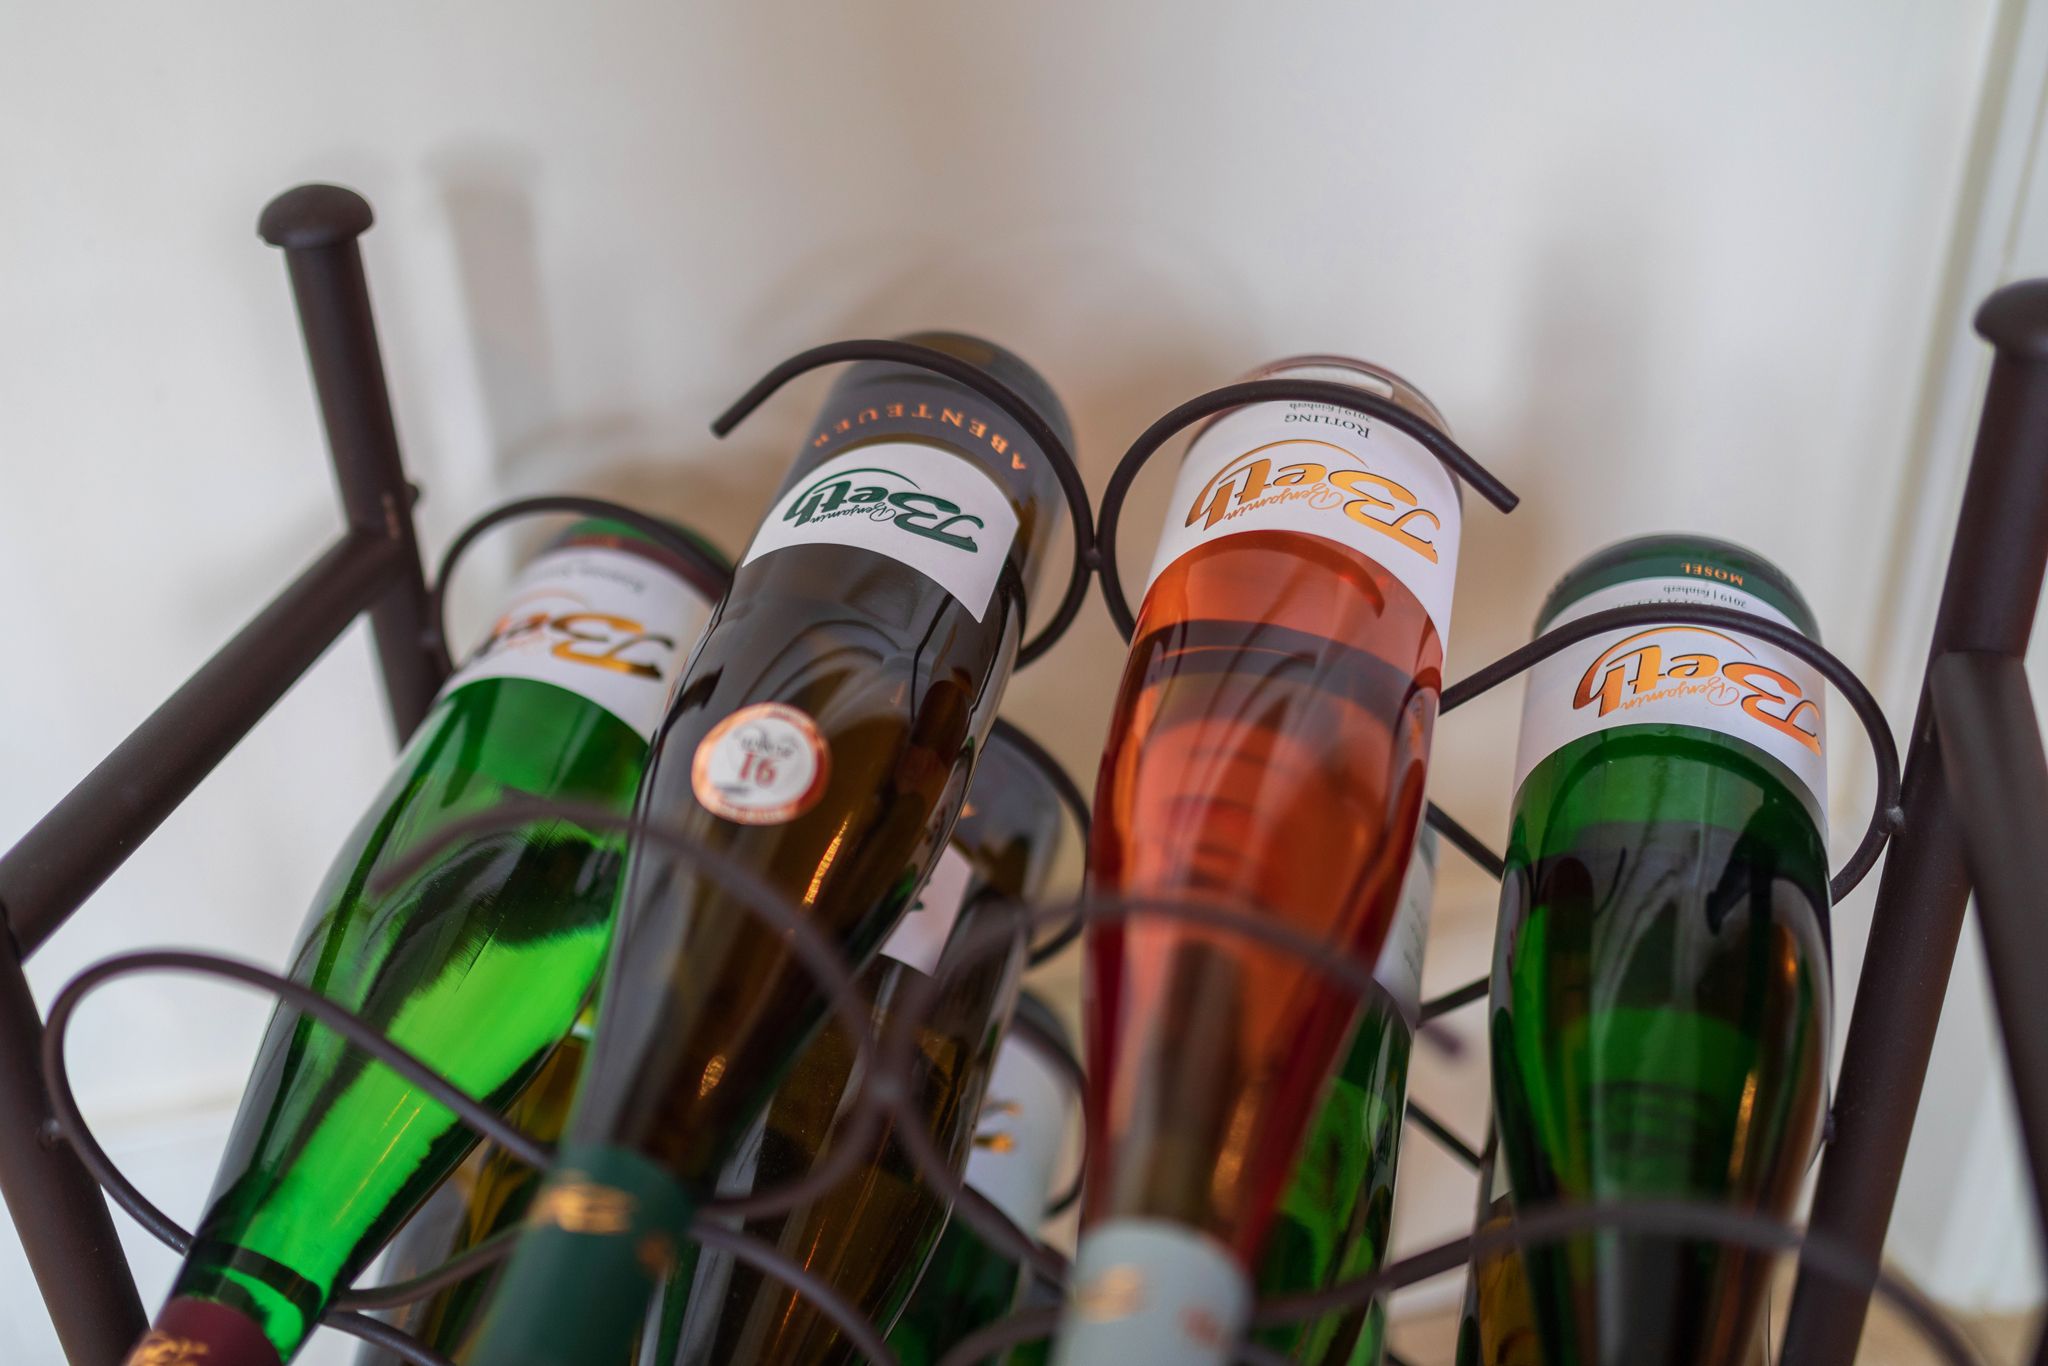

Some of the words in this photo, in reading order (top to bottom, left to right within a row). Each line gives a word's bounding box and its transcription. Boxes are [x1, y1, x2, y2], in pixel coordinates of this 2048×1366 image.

[1284, 413, 1370, 439] ROTLING
[782, 467, 985, 554] Beth
[809, 502, 897, 524] Benjamin
[1185, 439, 1441, 566] Beth
[1224, 482, 1344, 522] Benjamin
[1679, 562, 1744, 587] MOSEL
[1573, 627, 1823, 758] Beth
[1621, 676, 1740, 713] Benjamin
